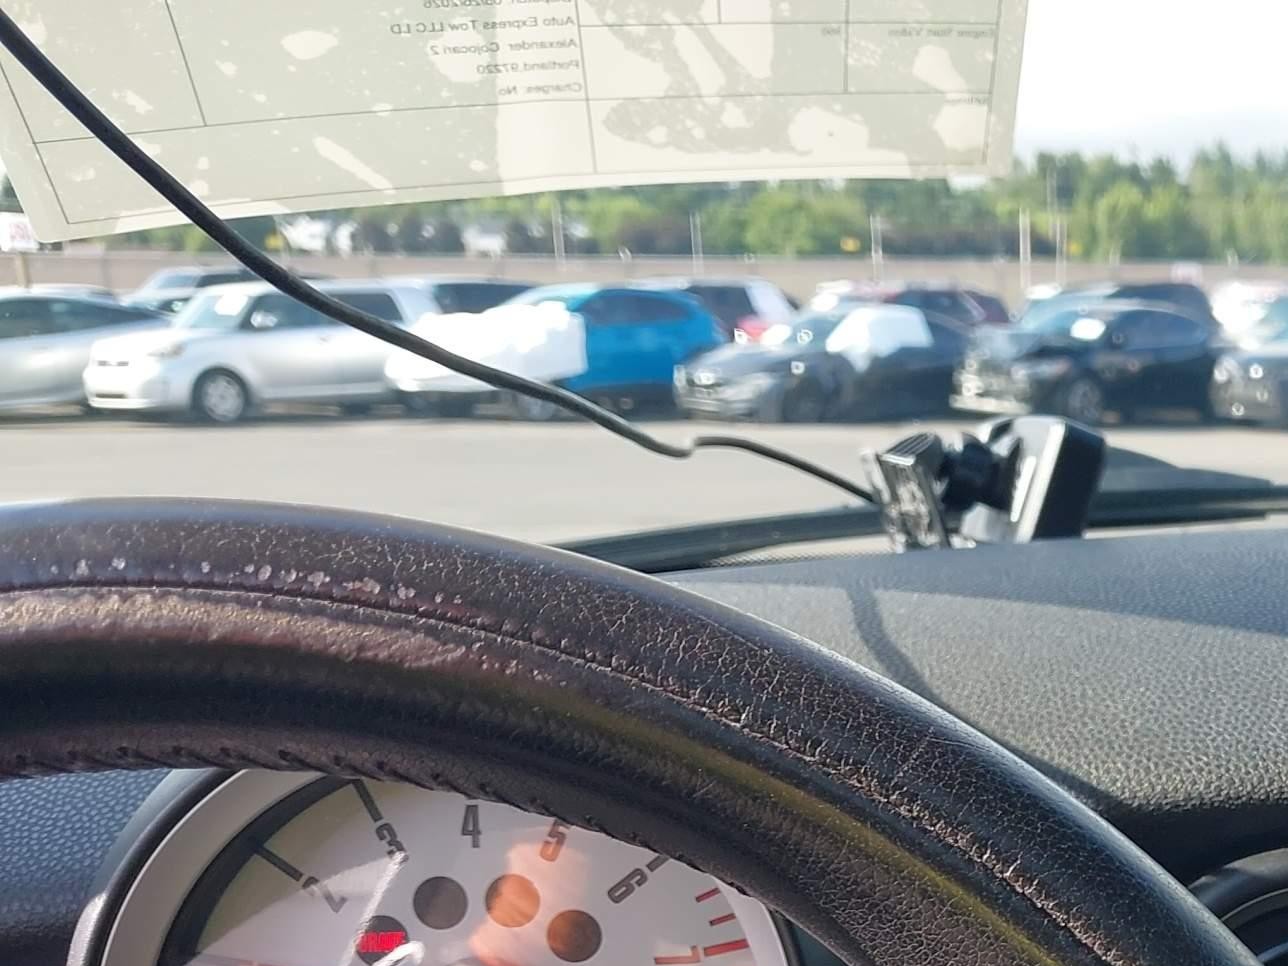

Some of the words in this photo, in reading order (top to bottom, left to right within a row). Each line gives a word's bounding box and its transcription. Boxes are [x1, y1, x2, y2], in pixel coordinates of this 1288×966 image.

[375, 822, 410, 864] 3
[461, 804, 482, 849] 4
[539, 818, 571, 862] 5
[607, 867, 649, 904] 6
[653, 945, 701, 965] 7
